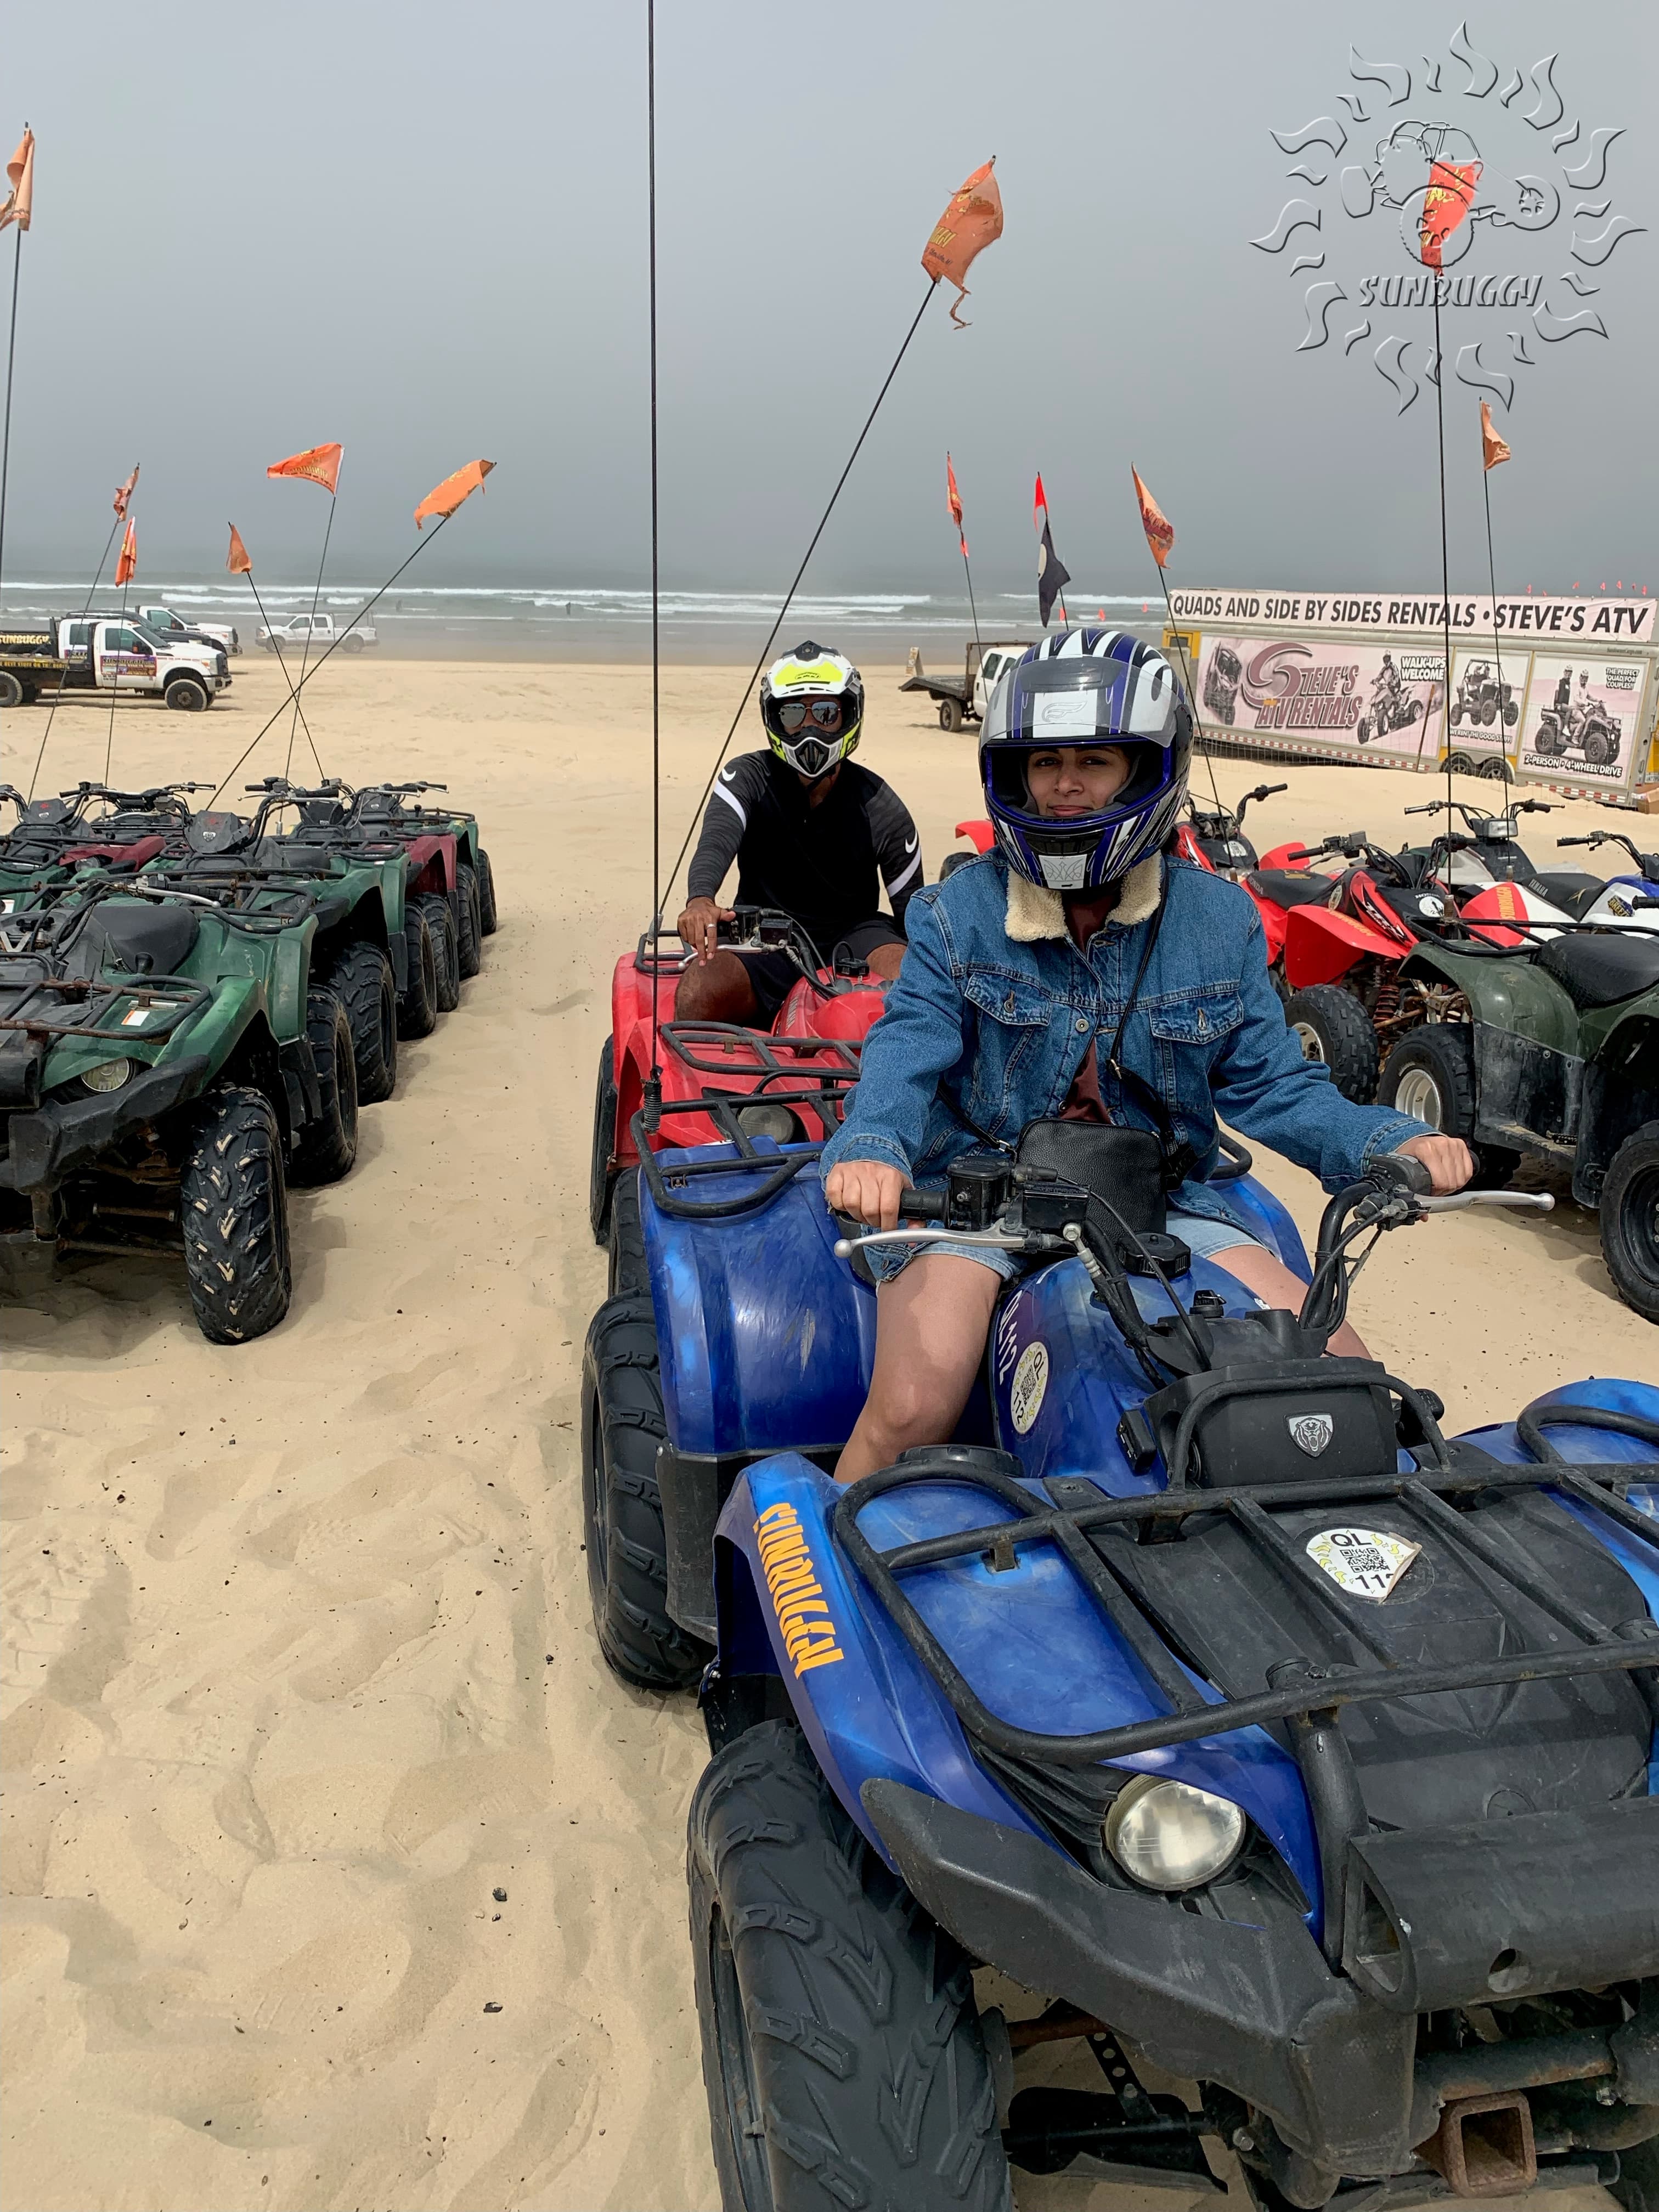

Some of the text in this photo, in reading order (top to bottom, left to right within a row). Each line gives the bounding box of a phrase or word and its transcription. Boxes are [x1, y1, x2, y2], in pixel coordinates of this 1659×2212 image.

[1173, 596, 1649, 634] QUADS AND SIDE BY SIDES RENTALS STEVE'S ATV
[1401, 656, 1446, 669] WALK-UPS
[1606, 667, 1639, 677] THE PERFECT
[1242, 642, 1359, 708] STEVE'S
[1401, 669, 1445, 681] WELCOME
[1255, 696, 1363, 728] ATV RENTALS
[1457, 730, 1470, 738] RENT
[1470, 731, 1479, 739] THE
[1479, 732, 1495, 741] GOOD
[1525, 754, 1560, 769] 2-PERSON
[1599, 766, 1623, 778] DRIVE
[1247, 876, 1263, 896] HONDA
[1528, 878, 1549, 897] YAMAHA
[1034, 1351, 1045, 1380] QL
[1013, 1391, 1025, 1425] 112
[1330, 1533, 1373, 1547] QL
